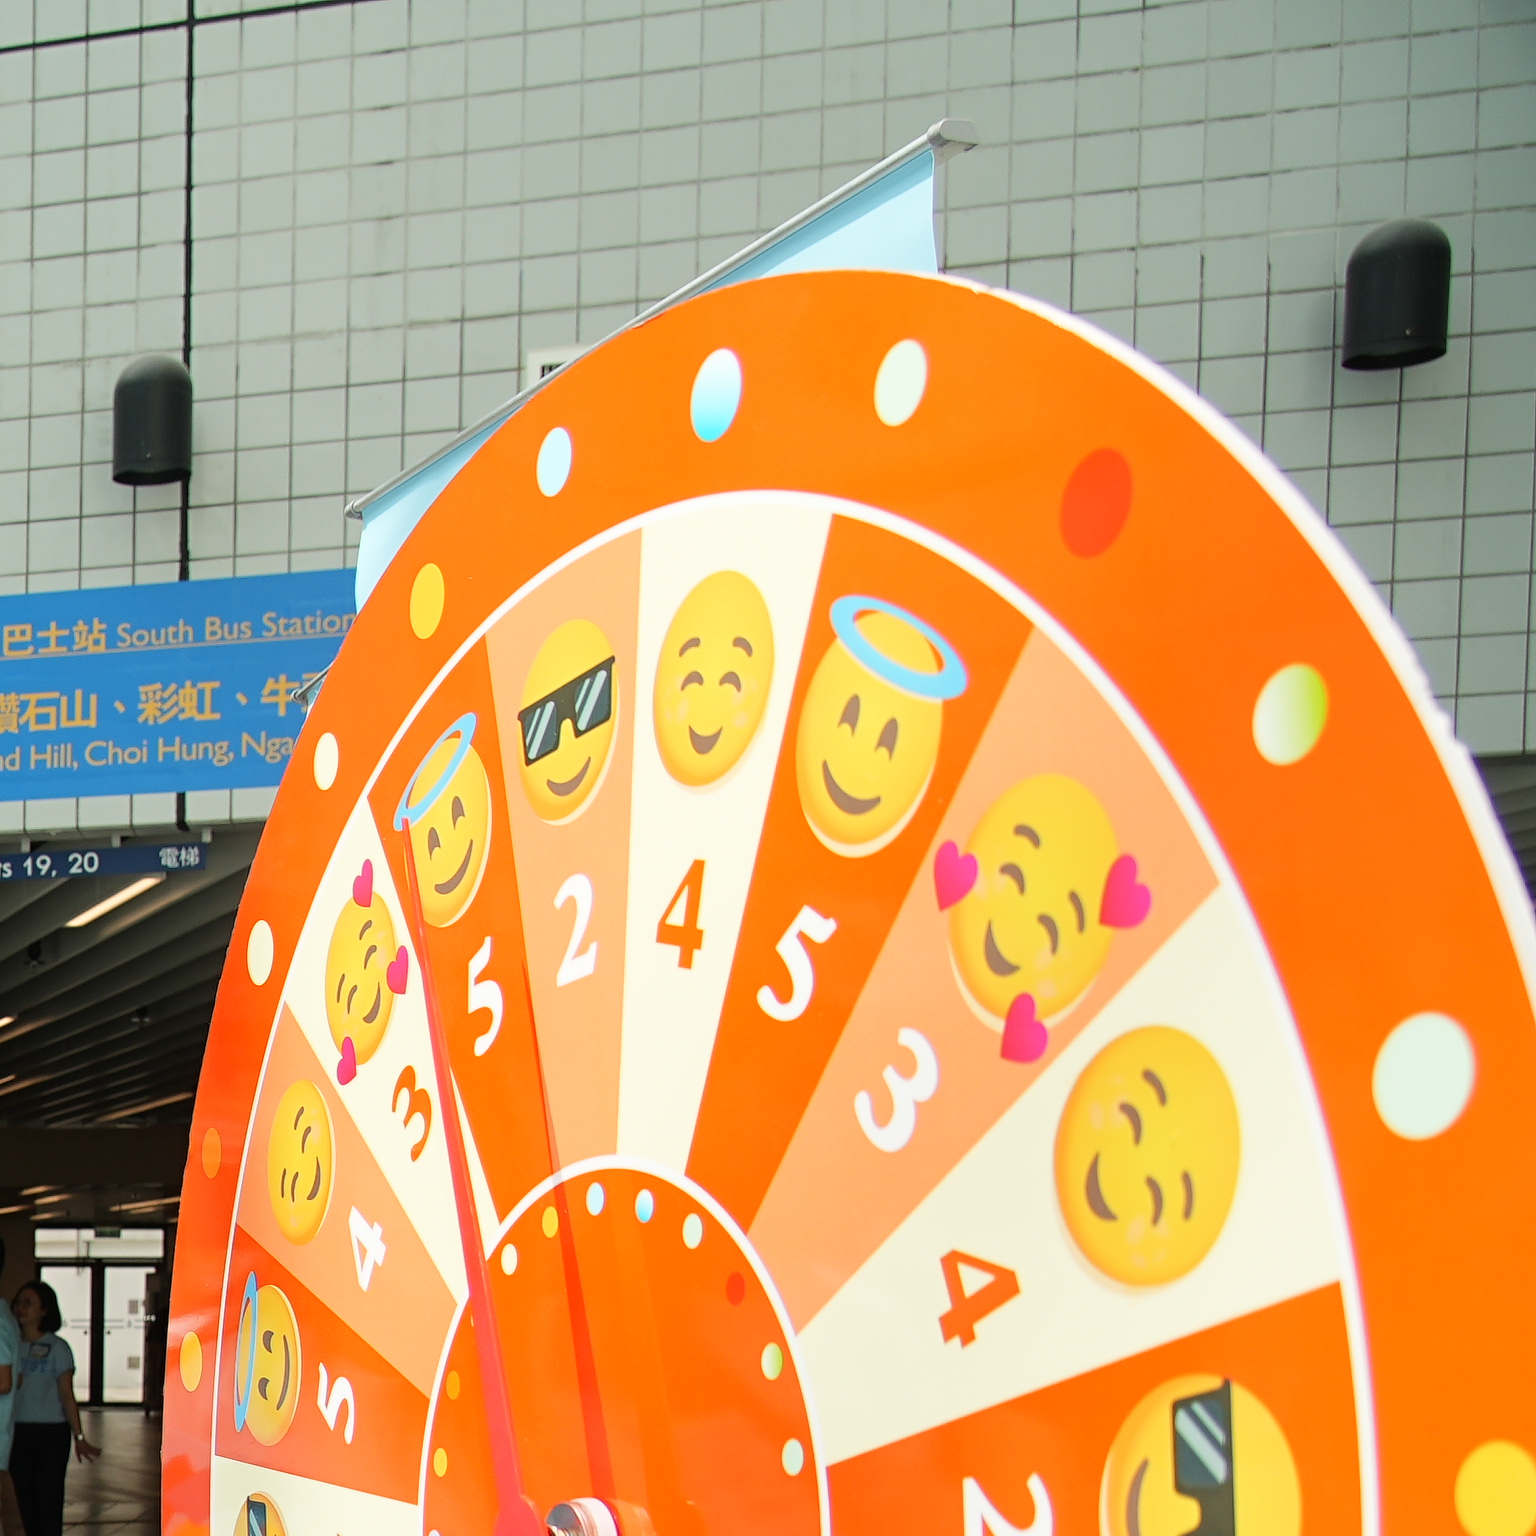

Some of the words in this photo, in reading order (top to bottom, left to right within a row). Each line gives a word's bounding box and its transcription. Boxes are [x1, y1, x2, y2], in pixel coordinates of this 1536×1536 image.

[116, 618, 194, 647] South
[204, 616, 253, 641] Bus
[29, 745, 79, 772] Hill,
[84, 738, 148, 767] Choi
[157, 735, 235, 767] Hung,
[241, 731, 295, 764] Nga
[23, 855, 58, 878] 19,
[68, 851, 100, 874] 20
[158, 845, 200, 869] 電梯
[554, 873, 599, 987] 2
[656, 859, 706, 969] 4
[468, 936, 504, 1056] 5
[757, 905, 837, 1021] 5
[392, 1065, 432, 1162] 3
[855, 1027, 940, 1152] 3
[349, 1206, 387, 1292] 4
[939, 1250, 1021, 1346] 4
[317, 1363, 355, 1444] 5
